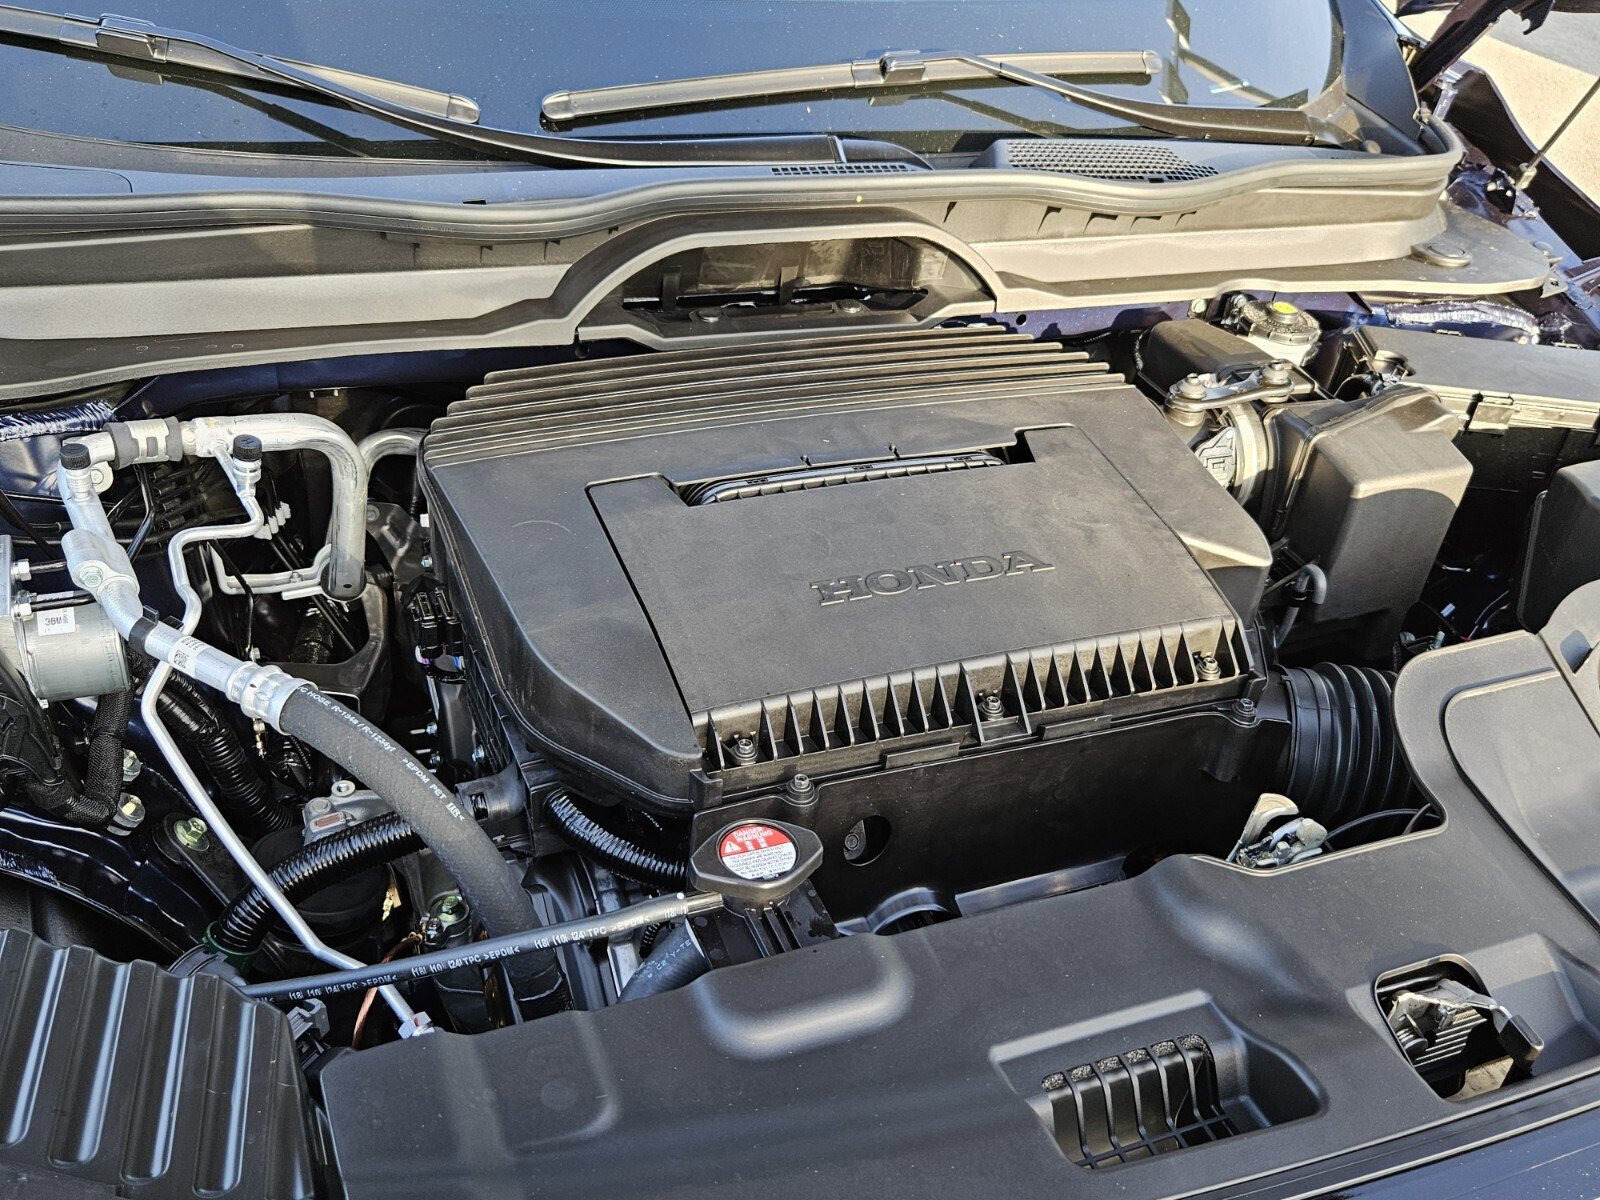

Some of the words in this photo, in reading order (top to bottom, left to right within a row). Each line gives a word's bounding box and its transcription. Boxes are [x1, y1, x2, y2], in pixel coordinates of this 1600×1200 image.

[809, 548, 1055, 607] HONDA
[306, 690, 332, 707] HOSE
[429, 783, 447, 800] PET
[462, 954, 482, 966] TPC
[586, 926, 607, 938] TPC
